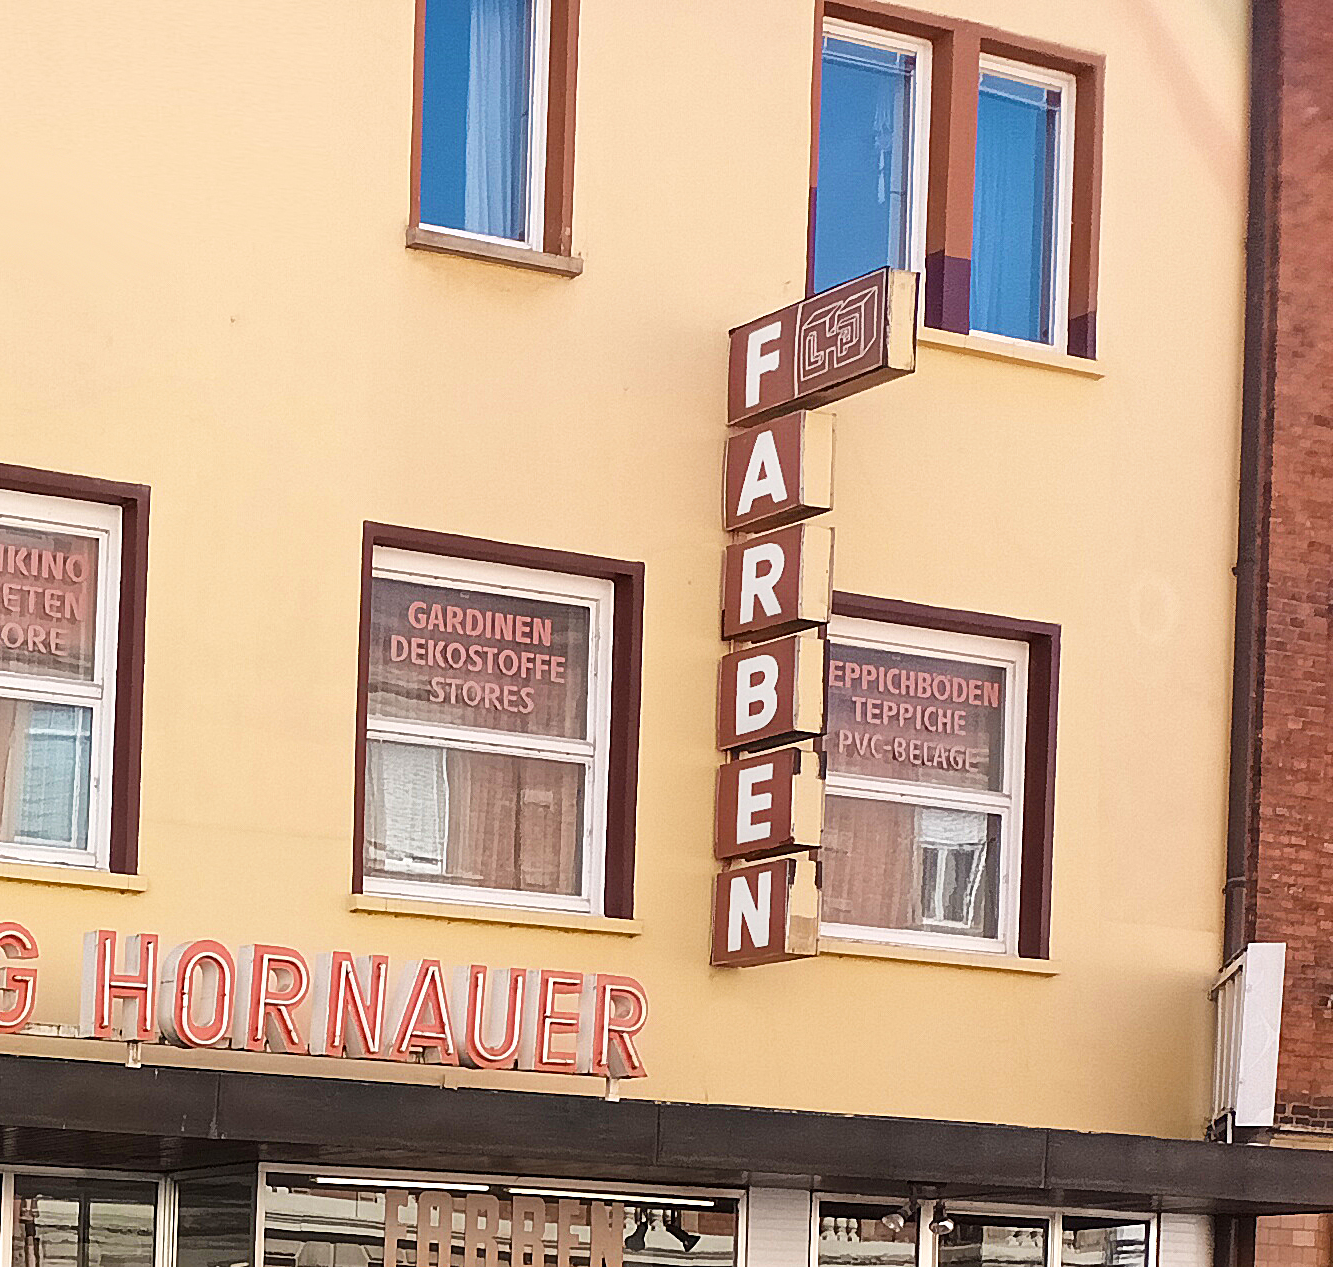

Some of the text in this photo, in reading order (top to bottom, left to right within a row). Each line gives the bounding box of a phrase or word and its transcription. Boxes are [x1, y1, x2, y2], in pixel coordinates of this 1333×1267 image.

[407, 601, 553, 647] GARDINEN
[390, 634, 566, 684] DEKOSTOFFE
[429, 676, 536, 714] STORES
[829, 659, 1001, 708] EPPICHBÖDEN
[851, 696, 967, 736] TEPPICHE
[85, 929, 649, 1079] HORNAUER
